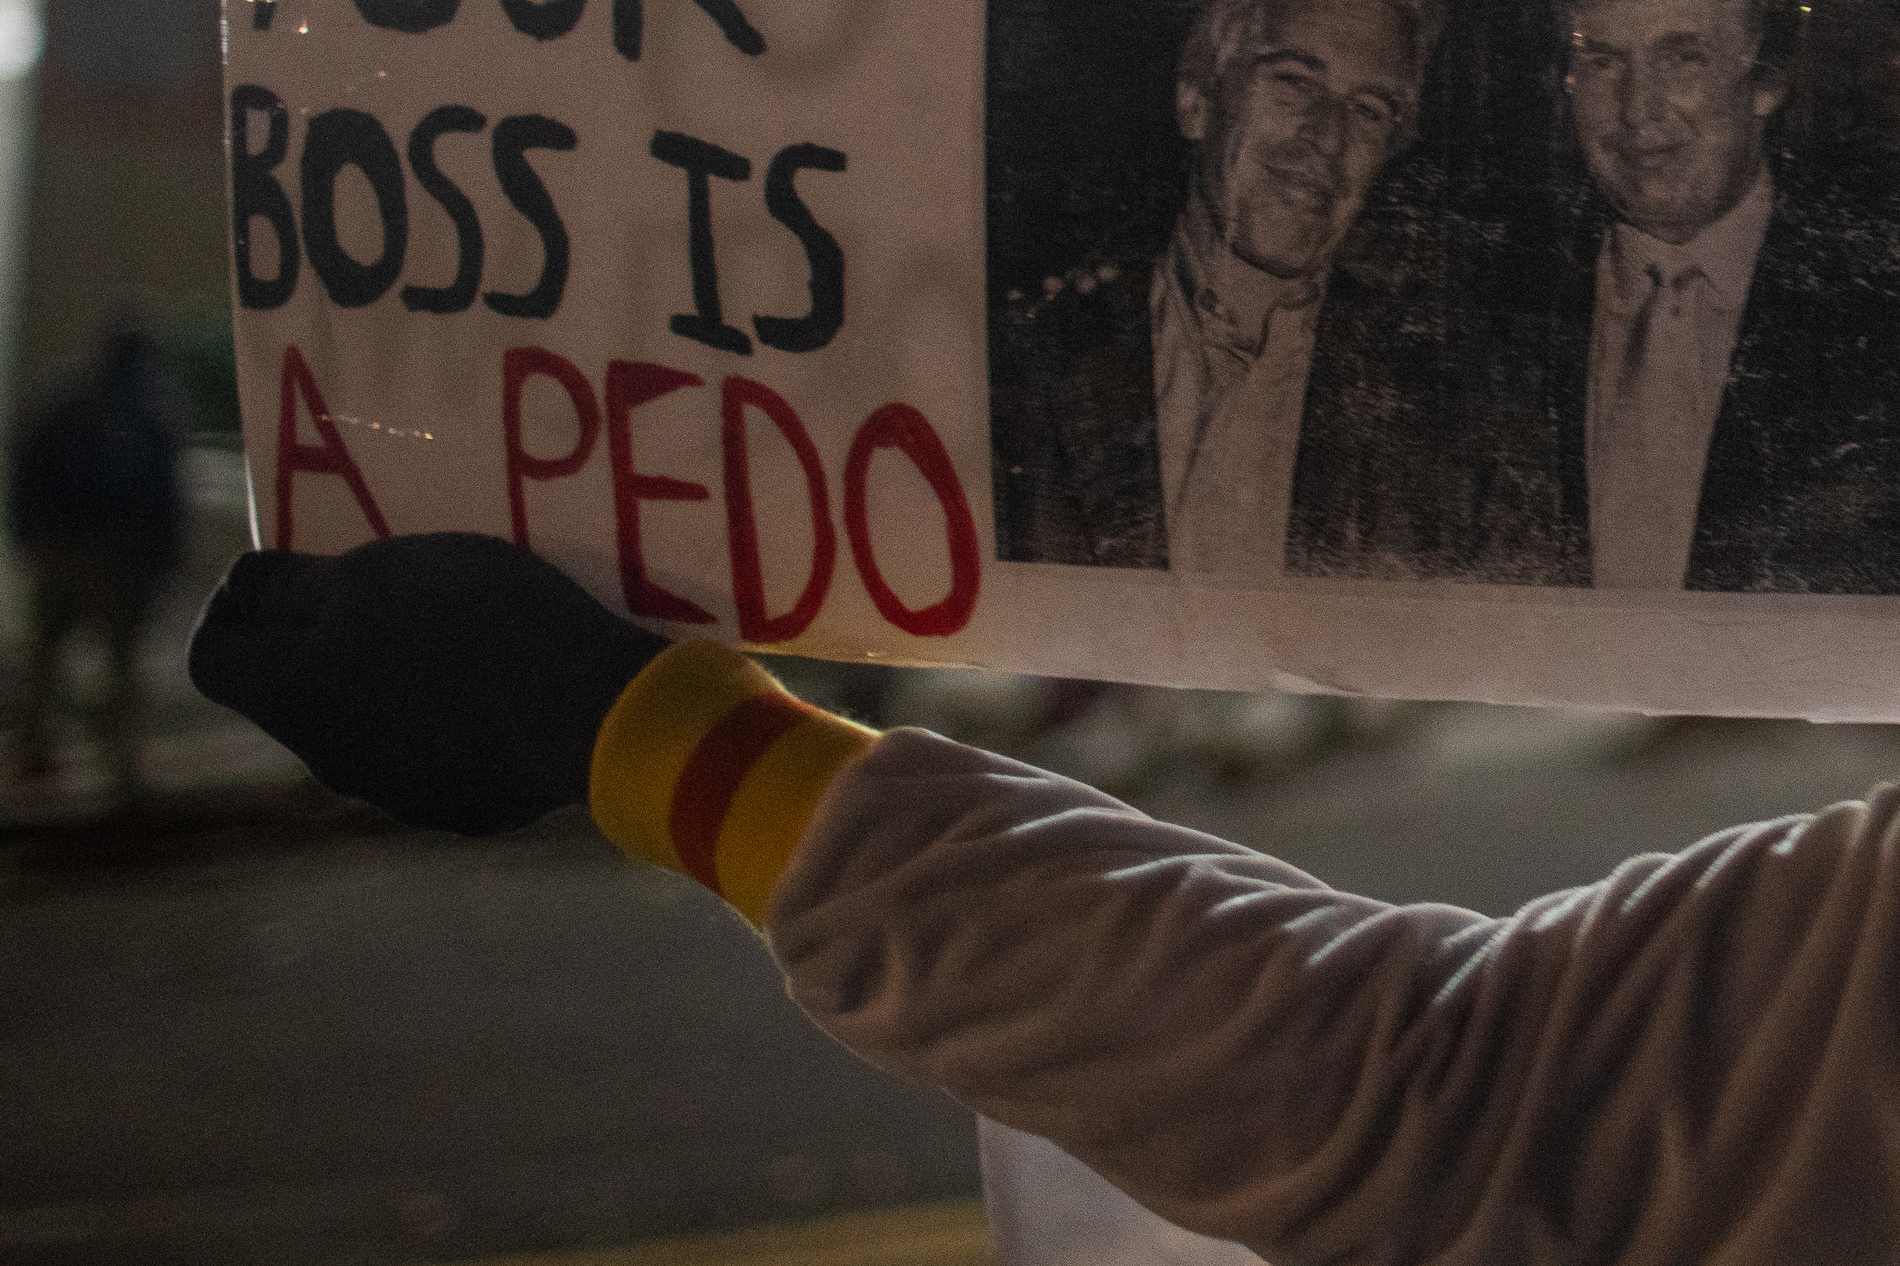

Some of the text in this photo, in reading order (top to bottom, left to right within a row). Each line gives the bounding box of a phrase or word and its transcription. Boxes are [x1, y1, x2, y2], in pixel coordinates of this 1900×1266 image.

[230, 84, 848, 356] BOSS IS
[275, 344, 982, 644] A PEDO
